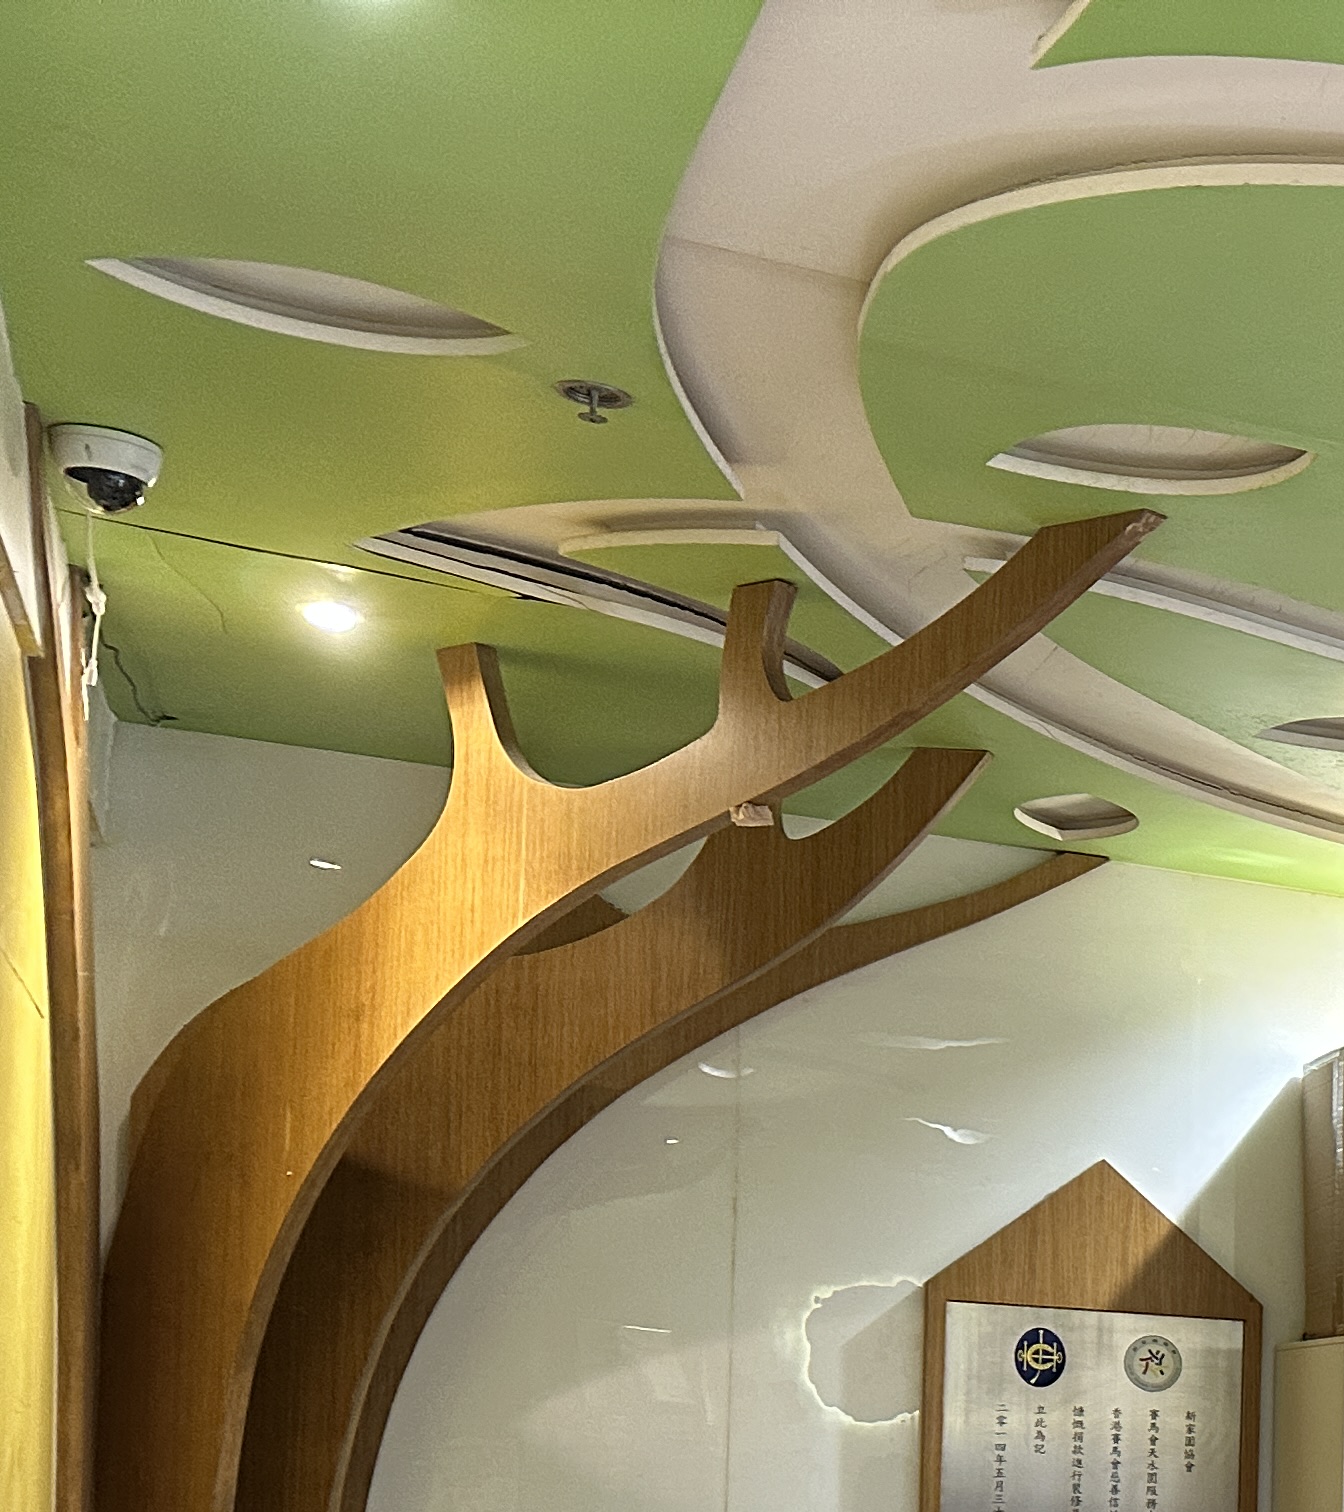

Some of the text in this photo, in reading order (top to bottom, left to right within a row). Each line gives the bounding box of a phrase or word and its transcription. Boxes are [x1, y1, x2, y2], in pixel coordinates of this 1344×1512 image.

[1033, 1405, 1047, 1455] 立此為記
[1184, 1410, 1197, 1473] 新家園協會
